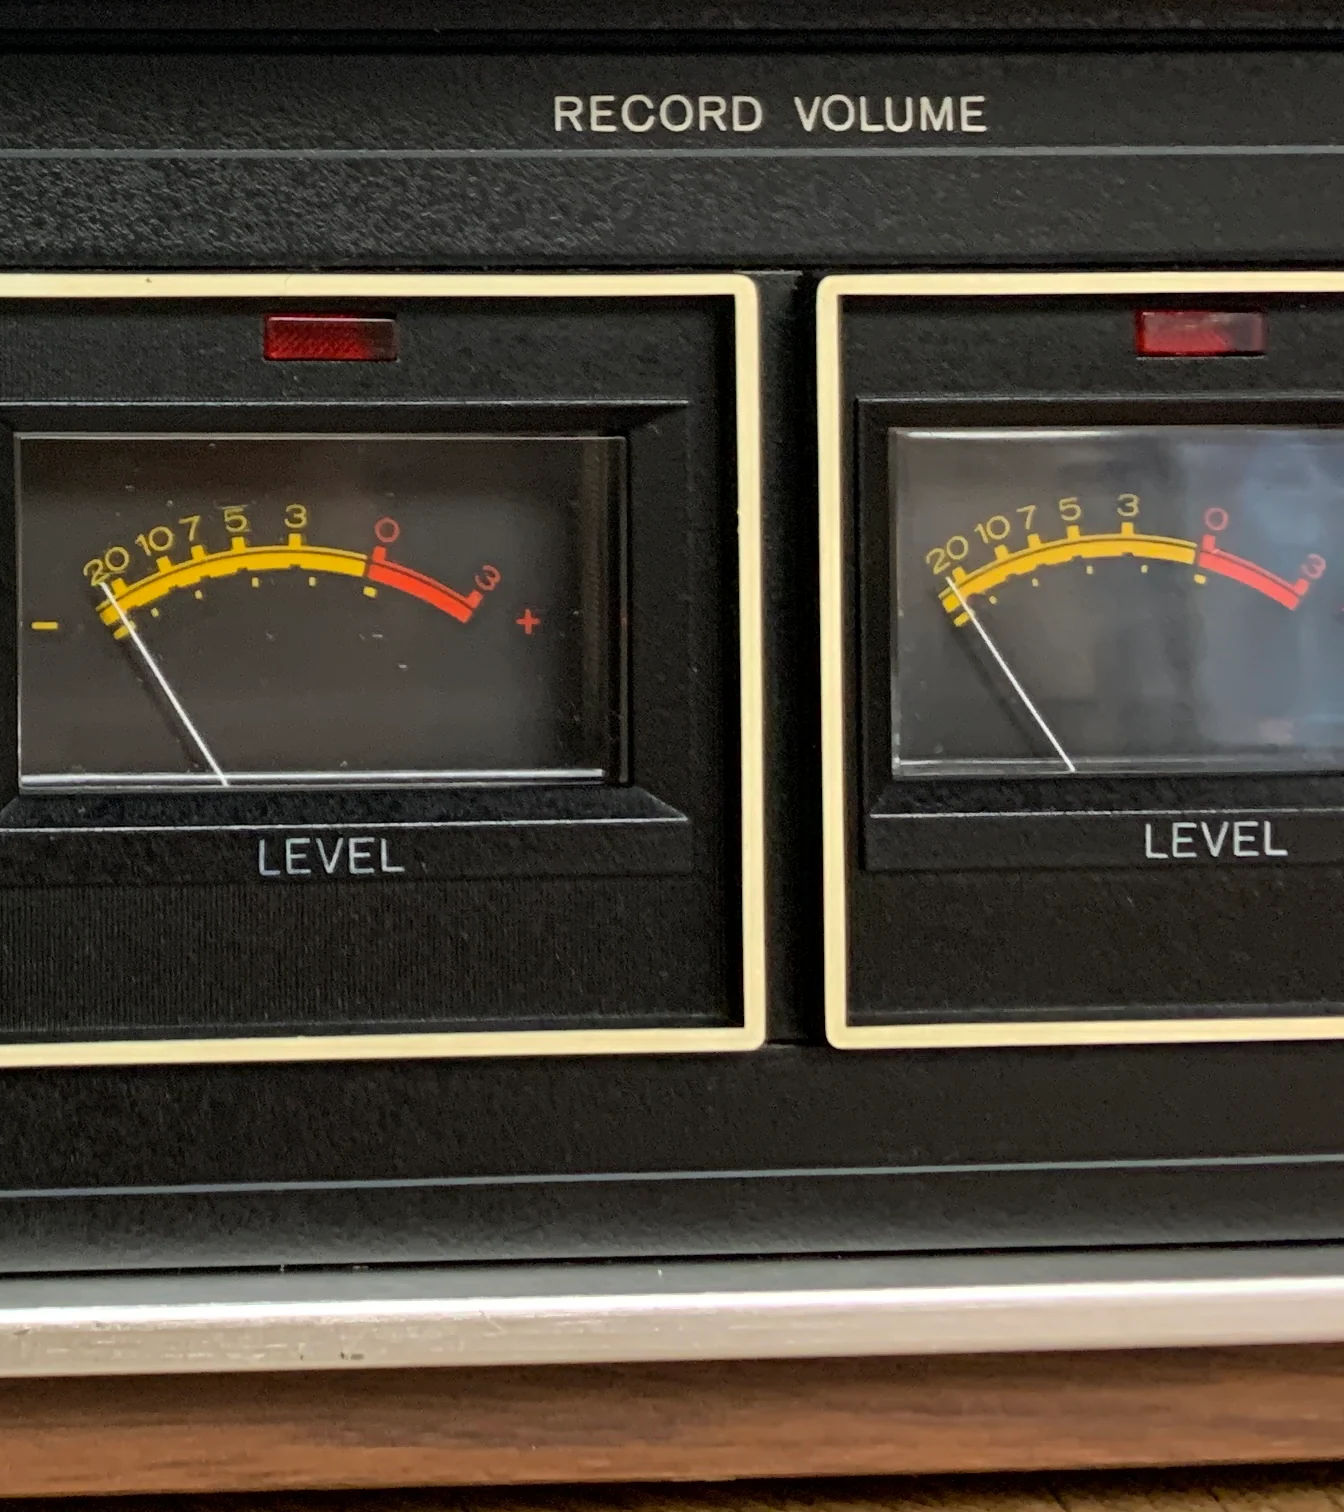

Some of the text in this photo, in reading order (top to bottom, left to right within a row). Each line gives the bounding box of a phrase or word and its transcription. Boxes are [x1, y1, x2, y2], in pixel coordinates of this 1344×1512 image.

[554, 94, 988, 133] RECORD VOLUME
[83, 546, 130, 587] 20
[135, 525, 174, 557] 10
[178, 514, 202, 542] 7
[223, 506, 250, 533] 5
[283, 504, 308, 529] 3
[374, 516, 401, 544] 0
[925, 534, 969, 577] 20
[974, 515, 1011, 546] 10
[1015, 504, 1038, 530] 7
[1058, 497, 1082, 522] 5
[1116, 493, 1141, 518] 3
[1203, 507, 1230, 532] 0
[258, 836, 406, 877] LEVEL
[1145, 820, 1289, 859] LEVEL
